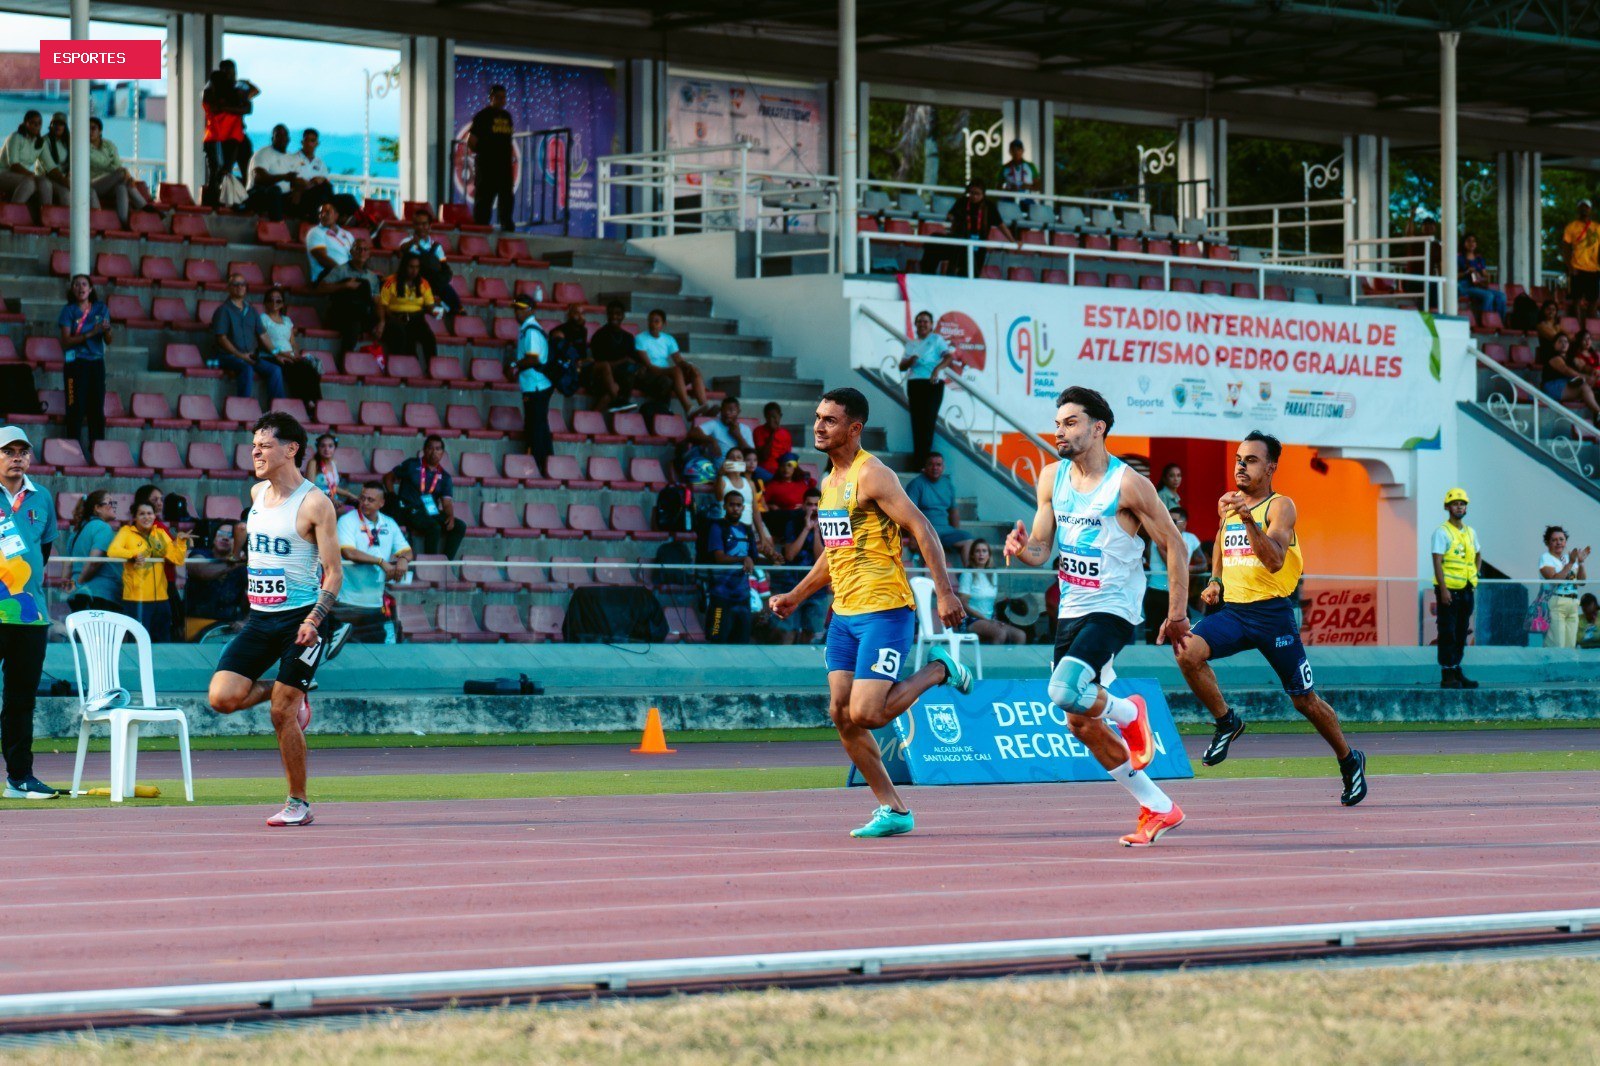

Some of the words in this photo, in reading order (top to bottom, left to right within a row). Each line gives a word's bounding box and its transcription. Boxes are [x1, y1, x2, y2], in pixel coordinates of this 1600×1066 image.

[1084, 304, 1181, 332] ESTADIO
[1187, 311, 1362, 344] INTERNACIONAL
[1366, 323, 1397, 346] DE
[1077, 337, 1210, 367] ATLETISMO
[1215, 346, 1289, 372] PEDRO
[1293, 351, 1403, 378] GRAJALES
[1126, 396, 1165, 409] Deporte
[1284, 401, 1345, 418] PARAATLETISMO
[1057, 515, 1102, 526] ARGENTINA
[1316, 590, 1351, 606] Cali
[1352, 593, 1371, 604] es
[1309, 606, 1377, 630] PARA
[882, 651, 897, 673] 5
[1303, 664, 1312, 684] 6
[923, 754, 961, 762] SANTIAGO
